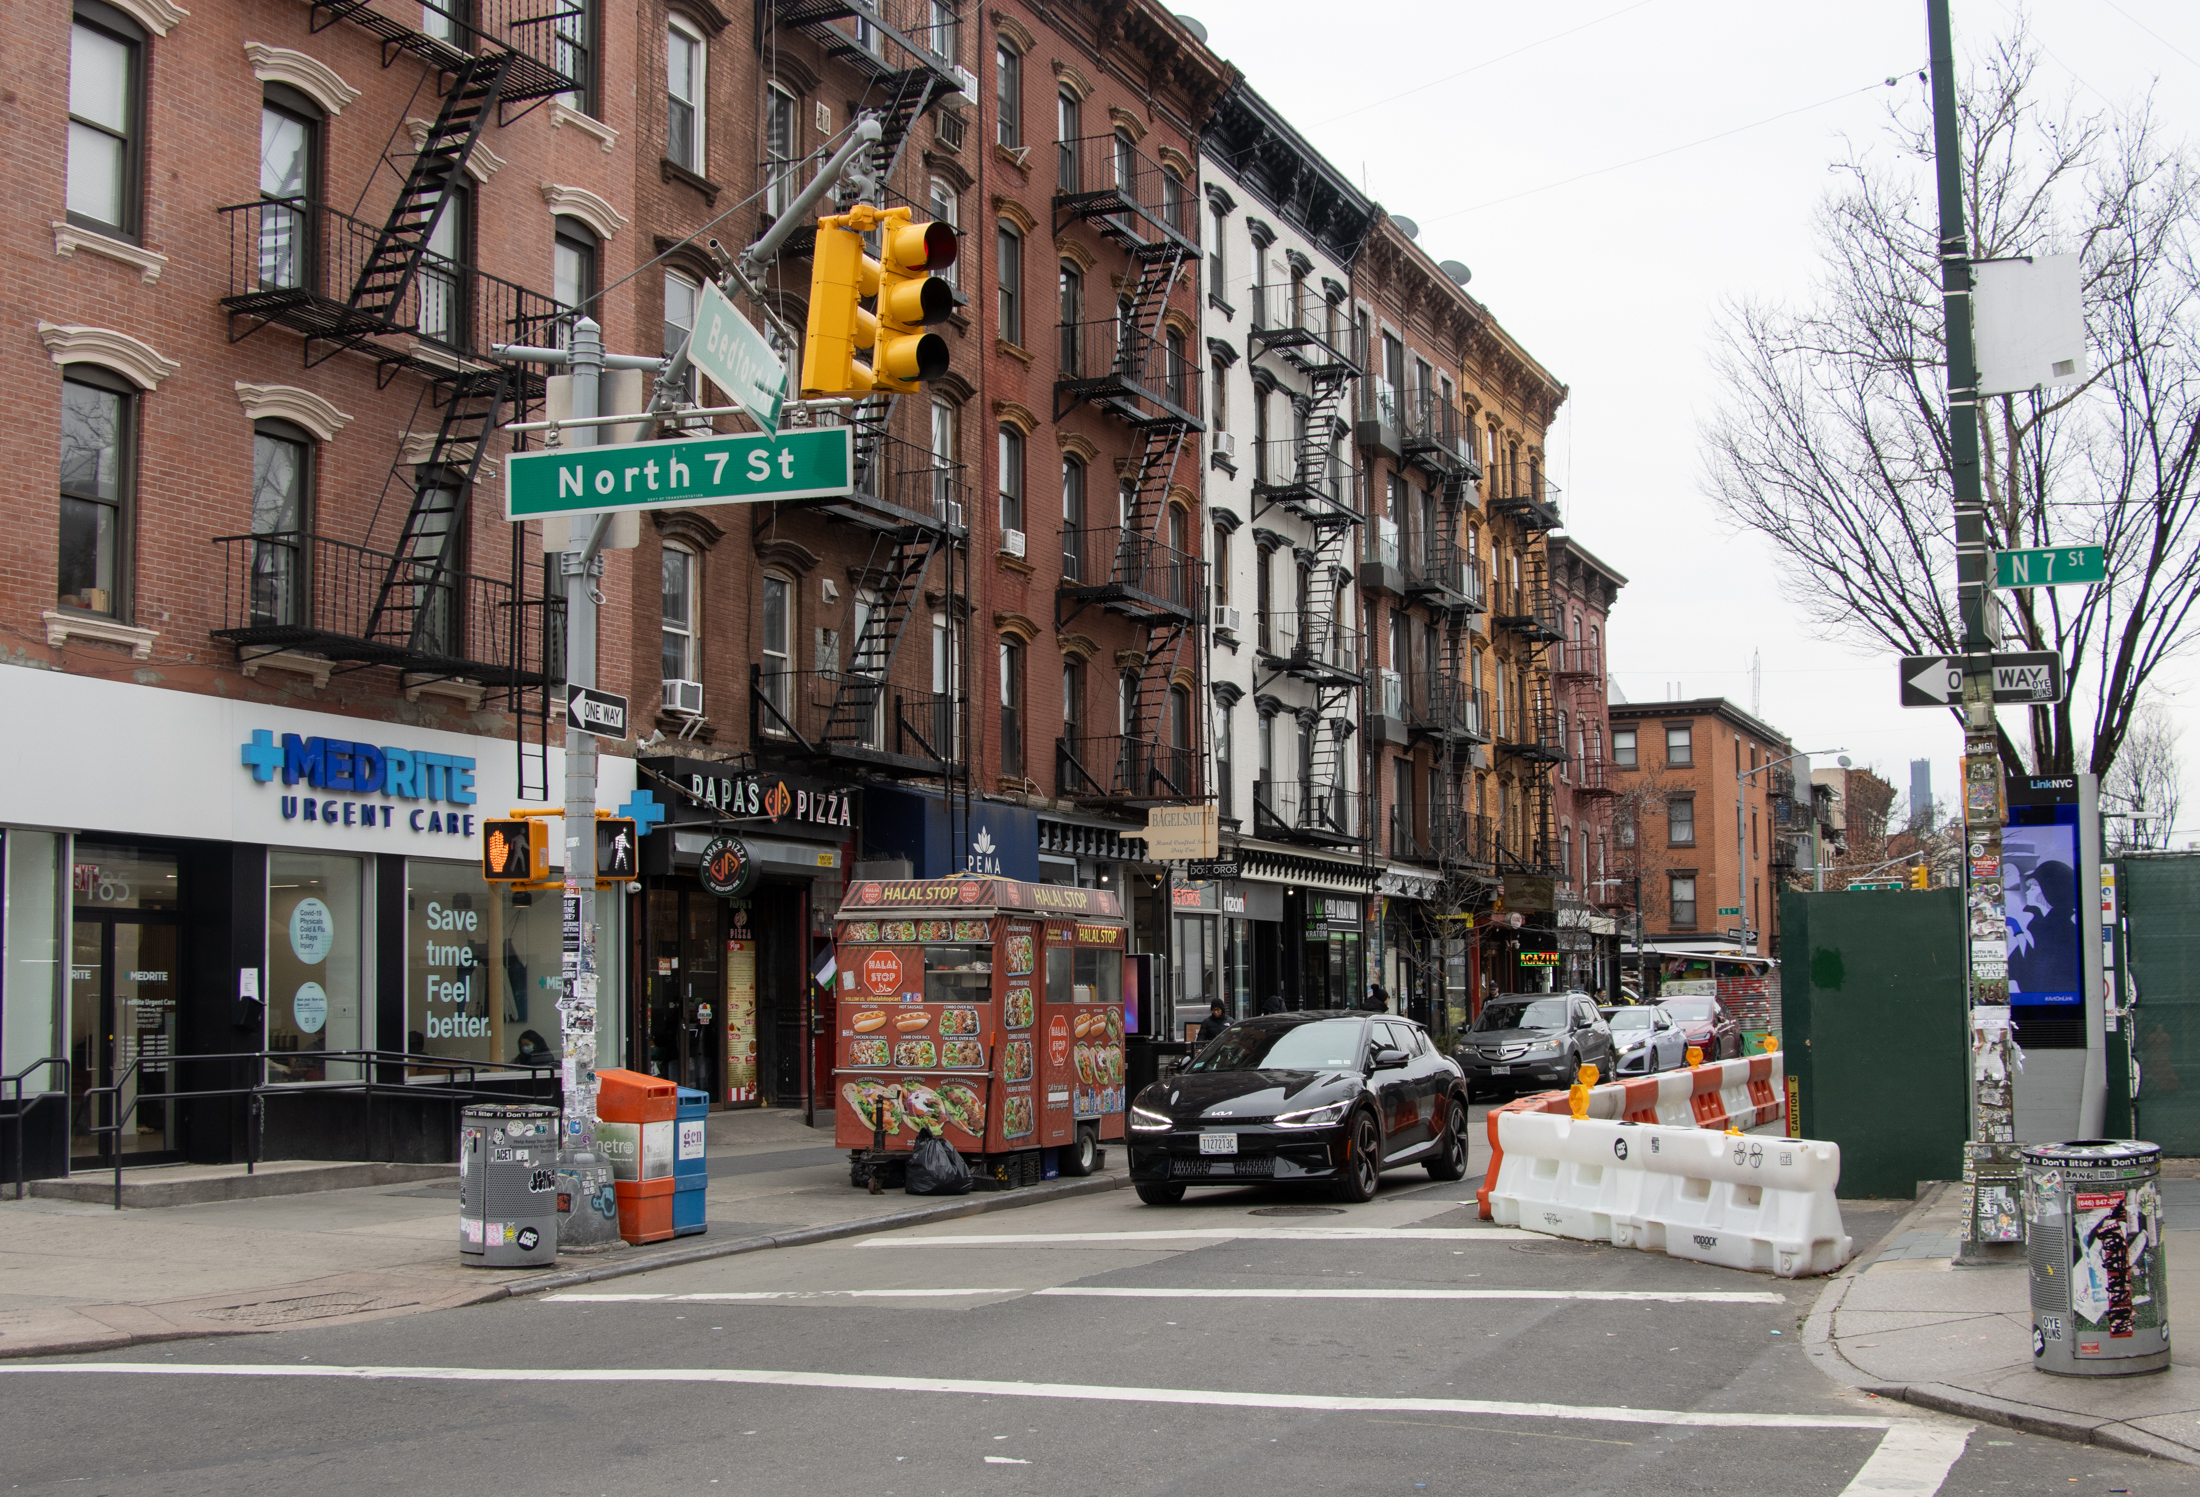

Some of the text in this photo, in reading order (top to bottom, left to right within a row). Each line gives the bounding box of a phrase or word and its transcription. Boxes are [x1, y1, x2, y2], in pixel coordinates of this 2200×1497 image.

[707, 313, 764, 396] Bedford
[559, 447, 795, 499] North 7 St
[2012, 550, 2085, 583] N 7 St
[2000, 667, 2043, 688] WAY
[2032, 678, 2050, 689] OYE
[2033, 688, 2052, 698] RUNS
[584, 701, 621, 725] ONE WAY
[2030, 779, 2074, 790] LinkNYC
[796, 790, 851, 827] PIZZA
[281, 795, 475, 836] URGENT CARE
[1152, 811, 1215, 828] BAGELSMITH
[1155, 839, 1172, 847] Hand
[726, 840, 747, 864] PIZZA
[968, 854, 1001, 875] PEMA
[1213, 866, 1238, 874] OROS
[73, 864, 99, 891] EXIT
[86, 870, 130, 902] 185
[884, 886, 959, 900] HALAL STOP
[1033, 888, 1064, 907] HALAL
[1064, 891, 1088, 909] STOP
[1324, 898, 1357, 920] CBD KRATOM
[300, 918, 324, 926] Physicals
[426, 901, 478, 932] Save
[1316, 923, 1328, 931] CBD
[300, 934, 318, 942] X-Rays
[730, 928, 752, 940] PIZZA
[1080, 928, 1117, 944] HALAL STOP
[1306, 930, 1328, 938] KRATOM
[300, 942, 315, 950] Injury
[426, 940, 478, 967] time.
[660, 960, 670, 970] Open
[868, 960, 898, 970] HALAL
[870, 972, 896, 982] STOP
[1976, 970, 2006, 978] STATE
[426, 974, 471, 1003] Feel
[426, 1010, 492, 1038] better.
[1052, 1026, 1067, 1037] HALAL
[1052, 1042, 1066, 1051] STOP
[1791, 1092, 1799, 1132] CAUTION
[683, 1130, 702, 1148] gcn
[1203, 1138, 1234, 1149] T127213C
[496, 1149, 512, 1161] ACET
[2042, 1159, 2066, 1167] Don't
[2069, 1159, 2094, 1167] litter
[2112, 1158, 2137, 1166] Don't
[1693, 1235, 1718, 1246] YODOCK
[2043, 1318, 2060, 1328] OYE
[2044, 1328, 2062, 1340] RUNS
